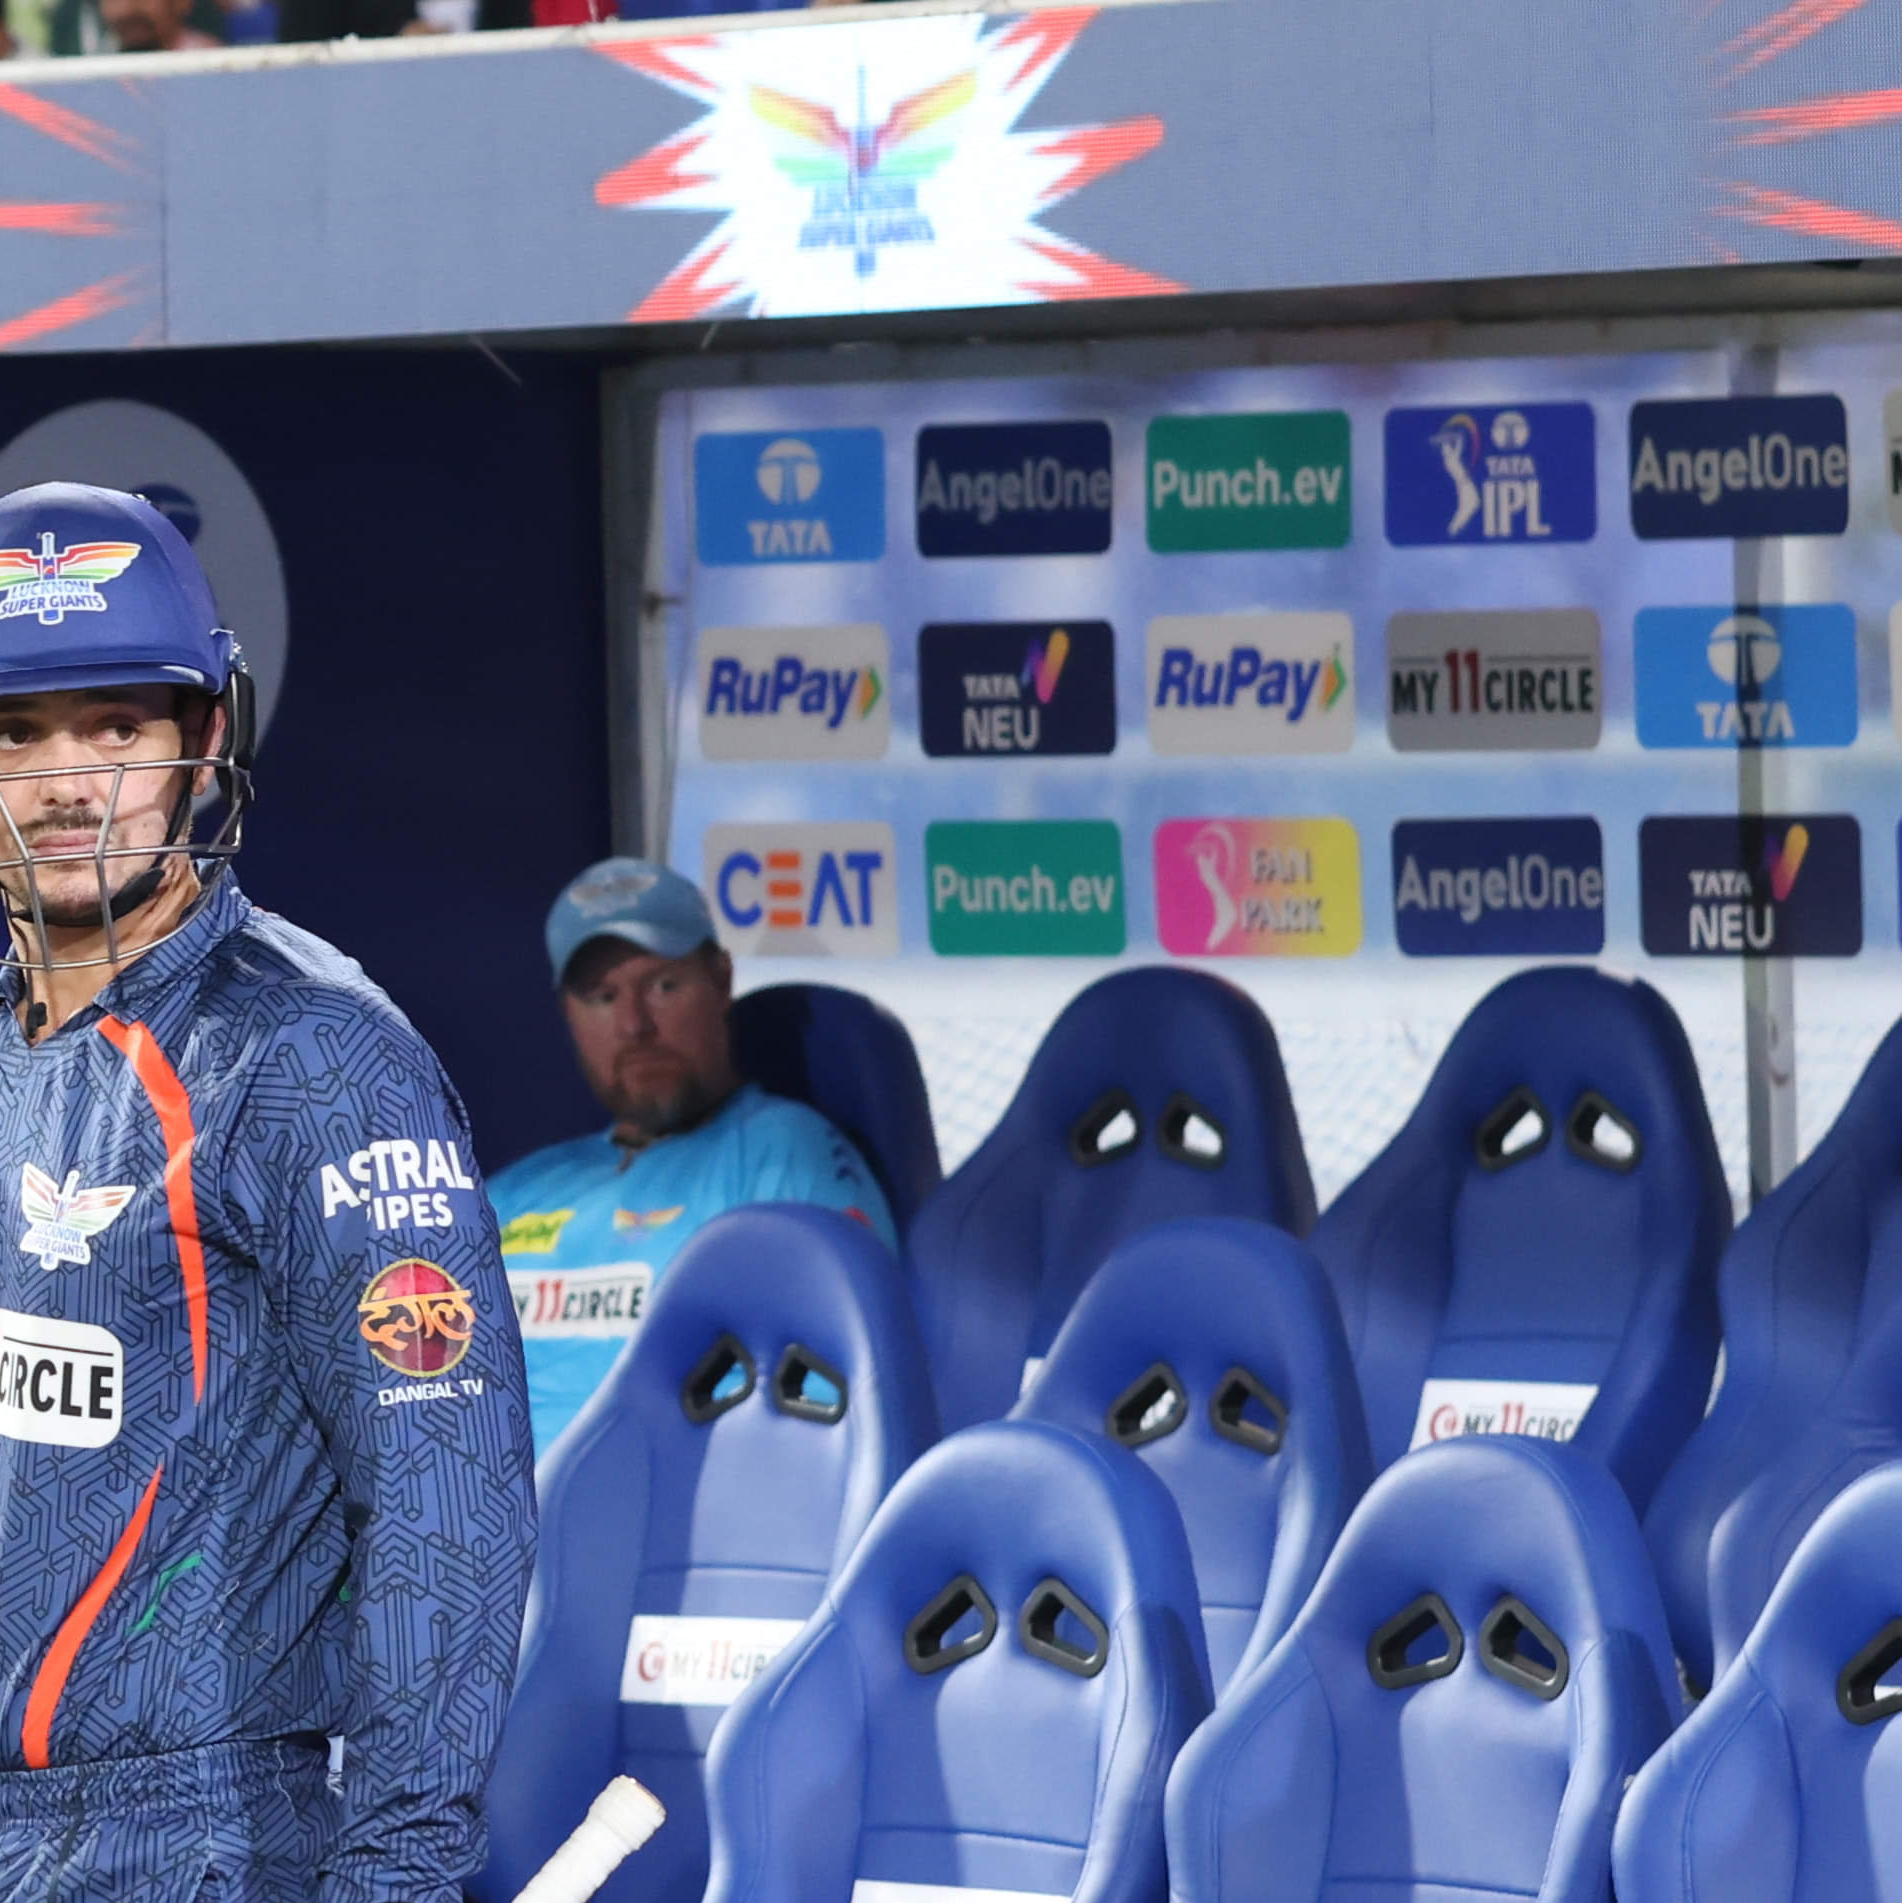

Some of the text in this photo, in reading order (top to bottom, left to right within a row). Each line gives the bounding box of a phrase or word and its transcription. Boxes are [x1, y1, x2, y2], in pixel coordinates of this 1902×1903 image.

[1153, 459, 1343, 510] Punch.ev
[1487, 456, 1535, 478] TATA
[1632, 435, 1847, 504] AngelOne
[918, 458, 1112, 524] AngelOne
[1483, 482, 1551, 536] IPL
[747, 520, 833, 556] TATA
[1, 594, 103, 616] SUPER GIANTS
[706, 656, 858, 729] RuPay
[963, 675, 1021, 700] TATA
[1155, 648, 1320, 724] RuPay
[962, 707, 1041, 750] NEU
[1697, 701, 1795, 741] TATA
[716, 850, 883, 930] CEAT
[933, 865, 1114, 915] Punch.ev
[1398, 854, 1603, 924] AngelOne
[1689, 871, 1752, 898] TATA
[1689, 905, 1775, 950] NEU
[320, 1138, 475, 1219] ASTRAL
[366, 1192, 453, 1231] IPES
[378, 1378, 484, 1407] DANGAL TV
